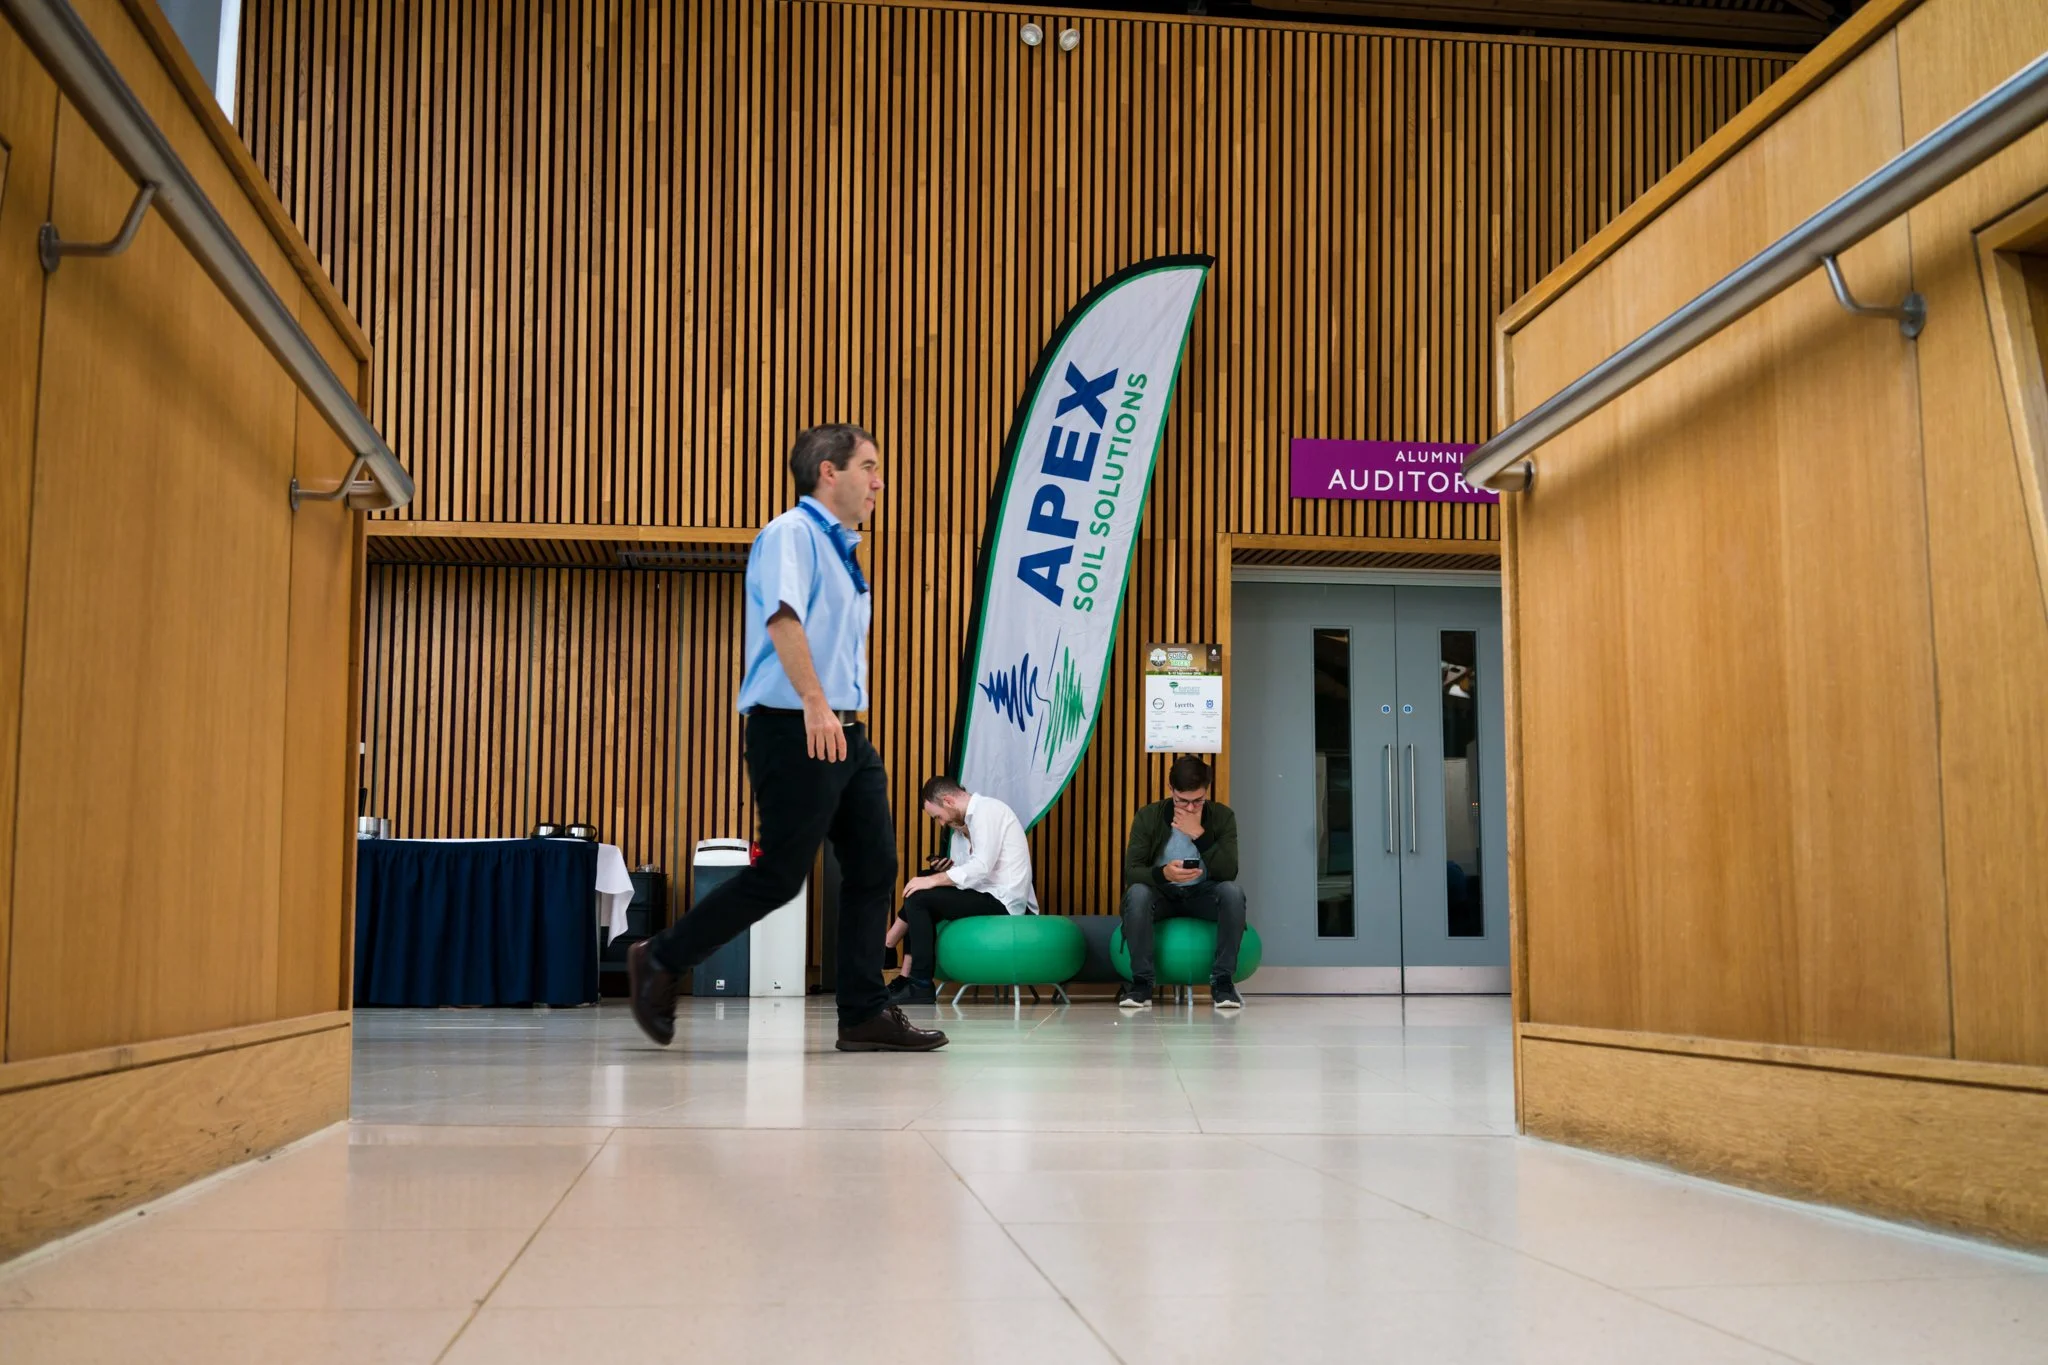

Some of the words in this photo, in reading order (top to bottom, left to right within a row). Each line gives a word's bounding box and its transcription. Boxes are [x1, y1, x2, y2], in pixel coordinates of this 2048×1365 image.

[1017, 360, 1119, 607] APEX
[1073, 546, 1105, 612] SOIL
[1089, 373, 1147, 537] SOLUTIONS
[1328, 468, 1500, 494] AUDITOR
[1395, 450, 1464, 464] ALUMNI
